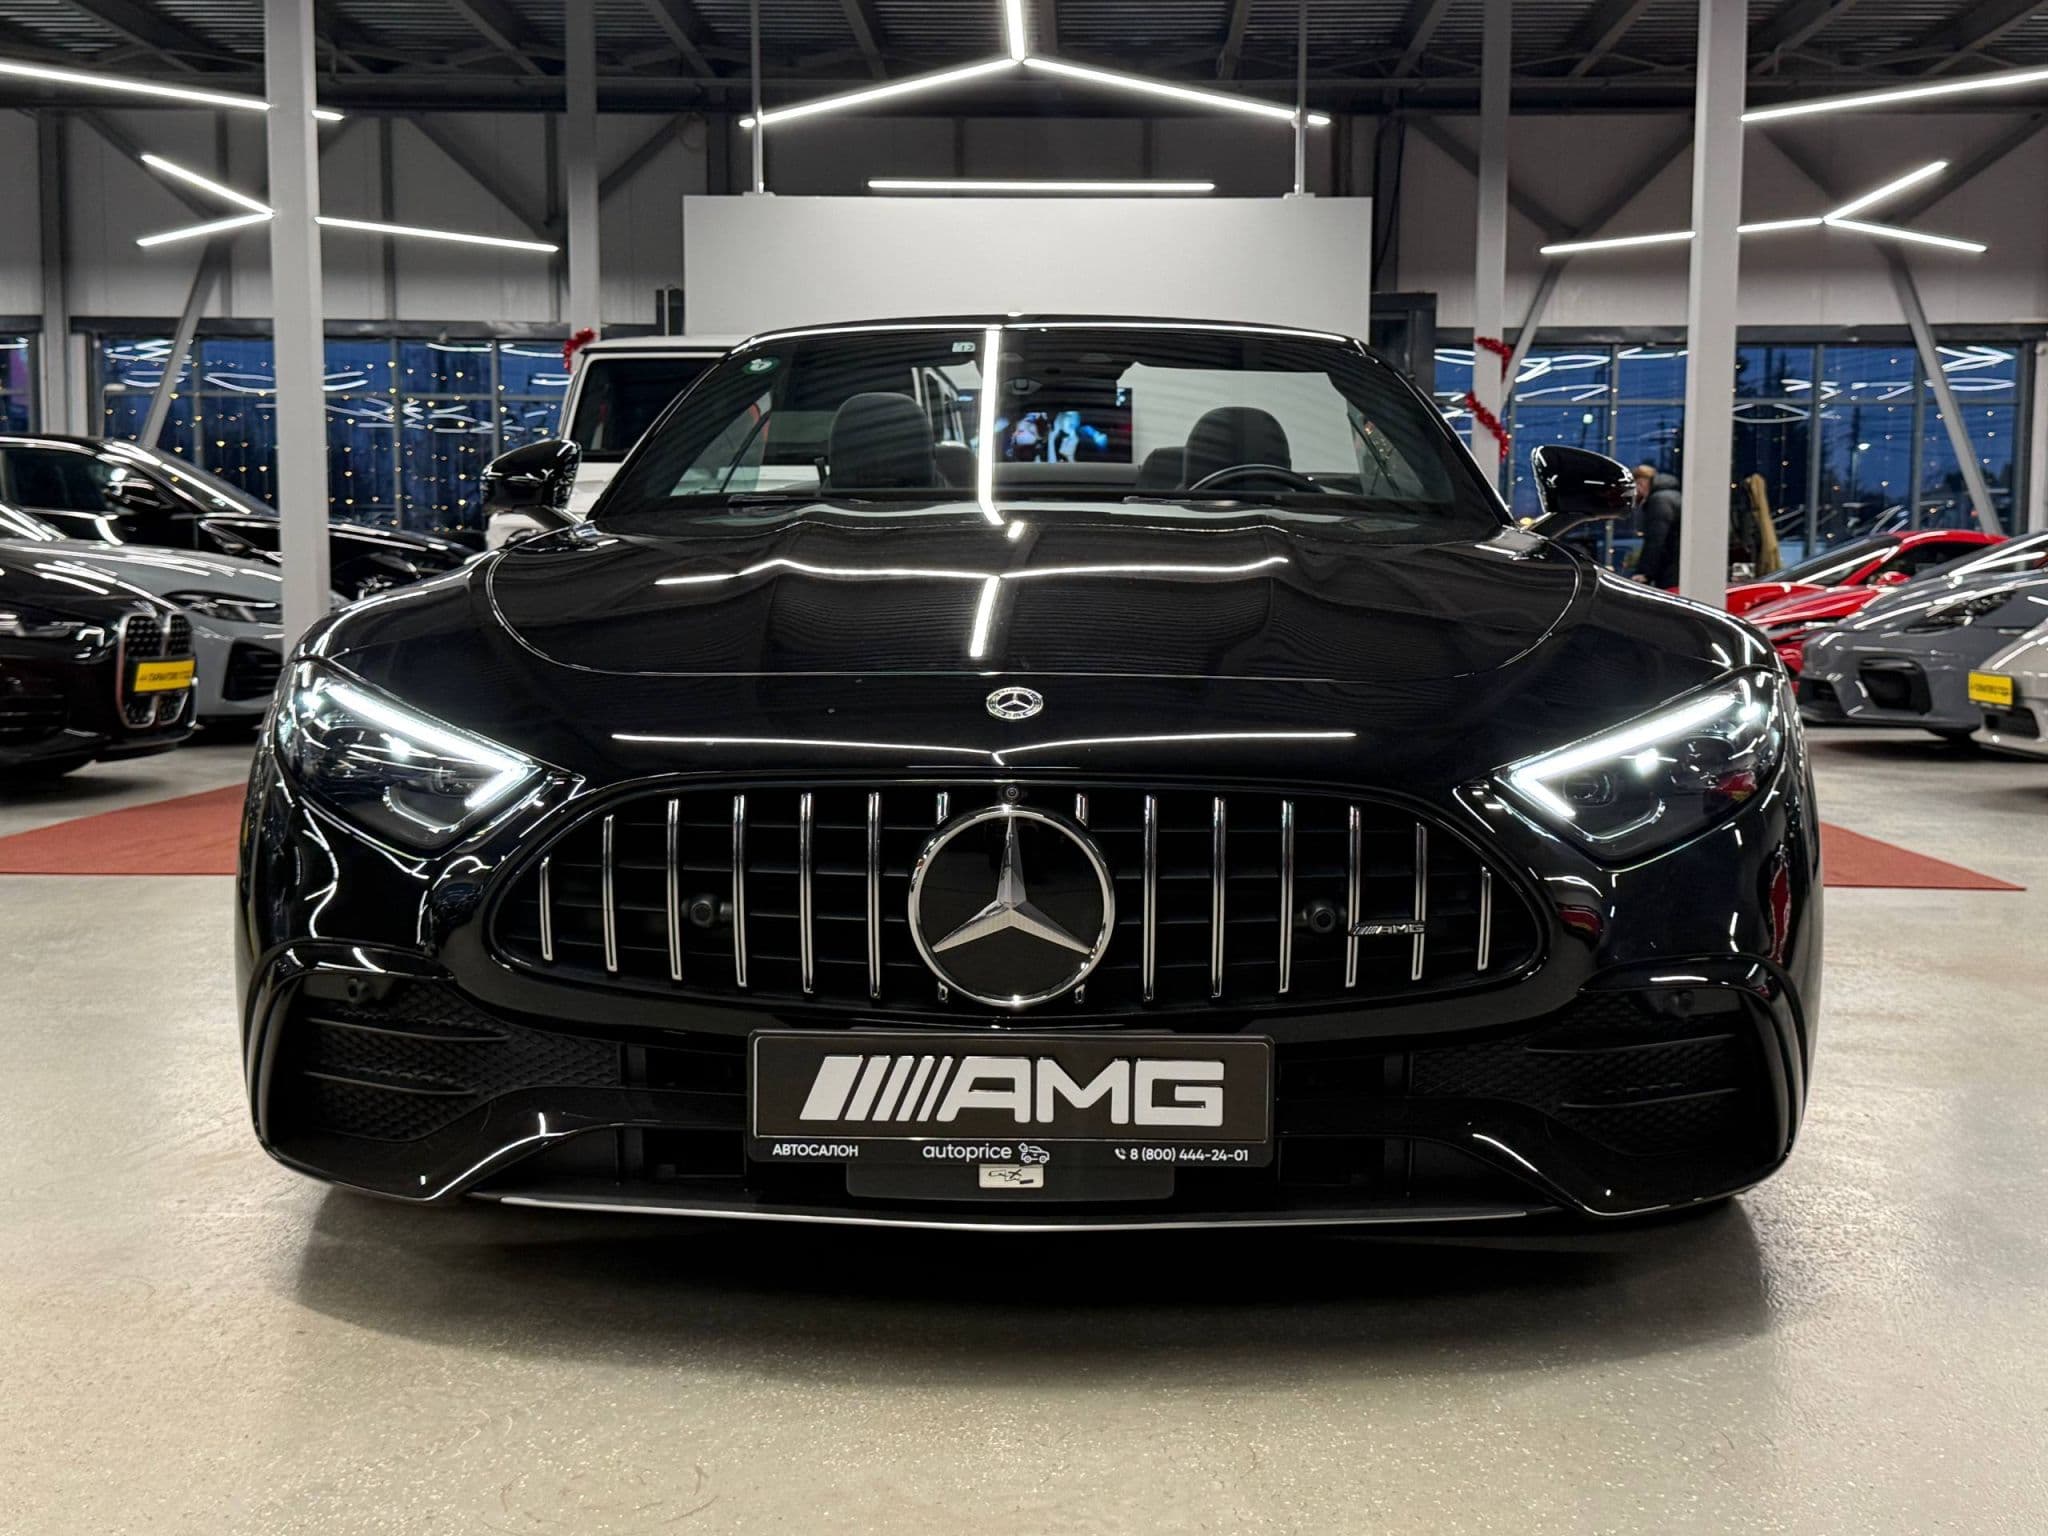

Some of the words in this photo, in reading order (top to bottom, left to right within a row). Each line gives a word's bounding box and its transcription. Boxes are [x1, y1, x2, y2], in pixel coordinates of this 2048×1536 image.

[1375, 924, 1425, 935] AMG
[937, 1056, 1225, 1126] AMG
[772, 1143, 859, 1157] АВТОСАЛОН
[922, 1143, 1013, 1163] autoprice
[1129, 1148, 1139, 1160] 8
[1141, 1147, 1176, 1162] (800)
[1179, 1148, 1249, 1162] 444-24-01
